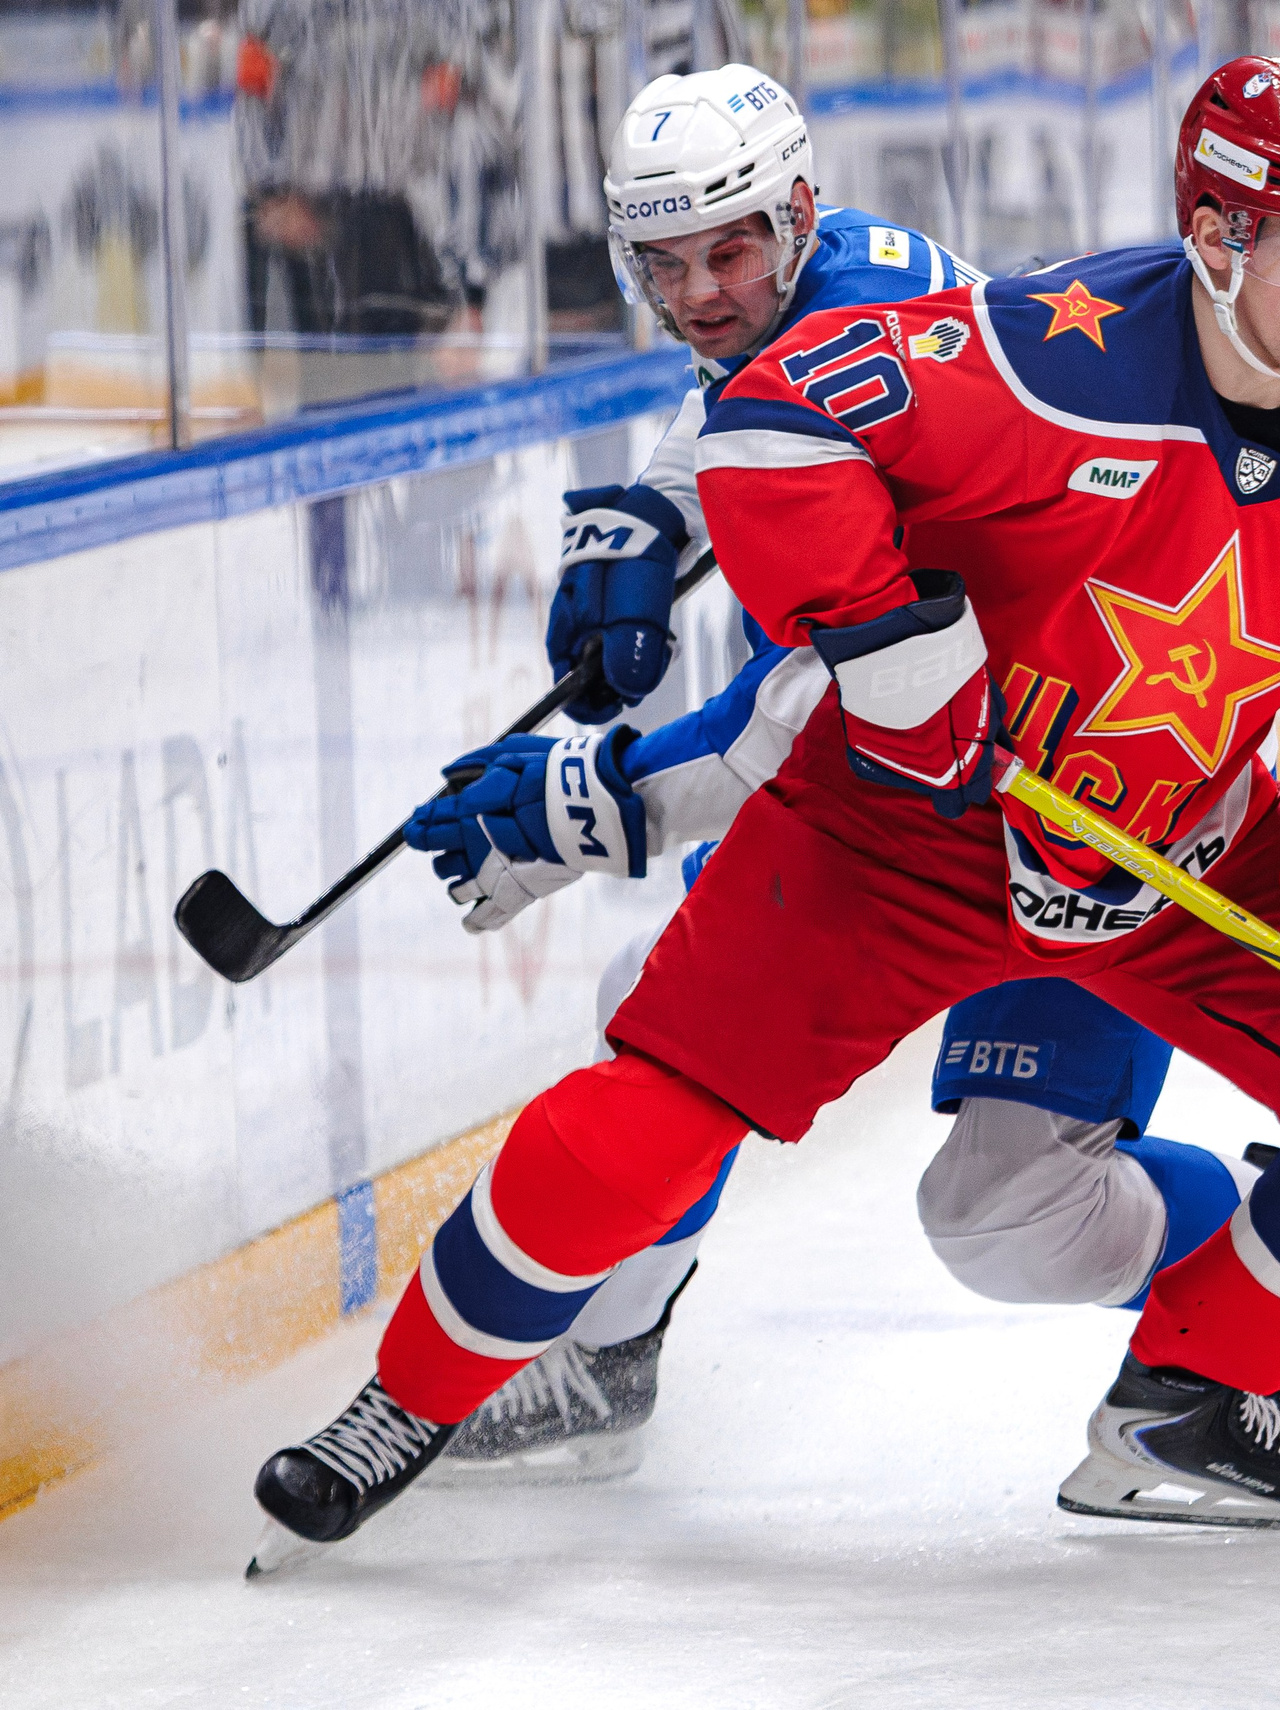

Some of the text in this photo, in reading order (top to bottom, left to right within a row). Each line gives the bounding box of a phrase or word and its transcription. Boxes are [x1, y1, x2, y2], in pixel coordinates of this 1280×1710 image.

[744, 81, 778, 112] ВТБ
[650, 111, 671, 142] 7
[781, 133, 807, 162] CCM
[779, 318, 914, 433] 10
[1089, 466, 1140, 489] МИР
[969, 1041, 1040, 1079] ВТБ
